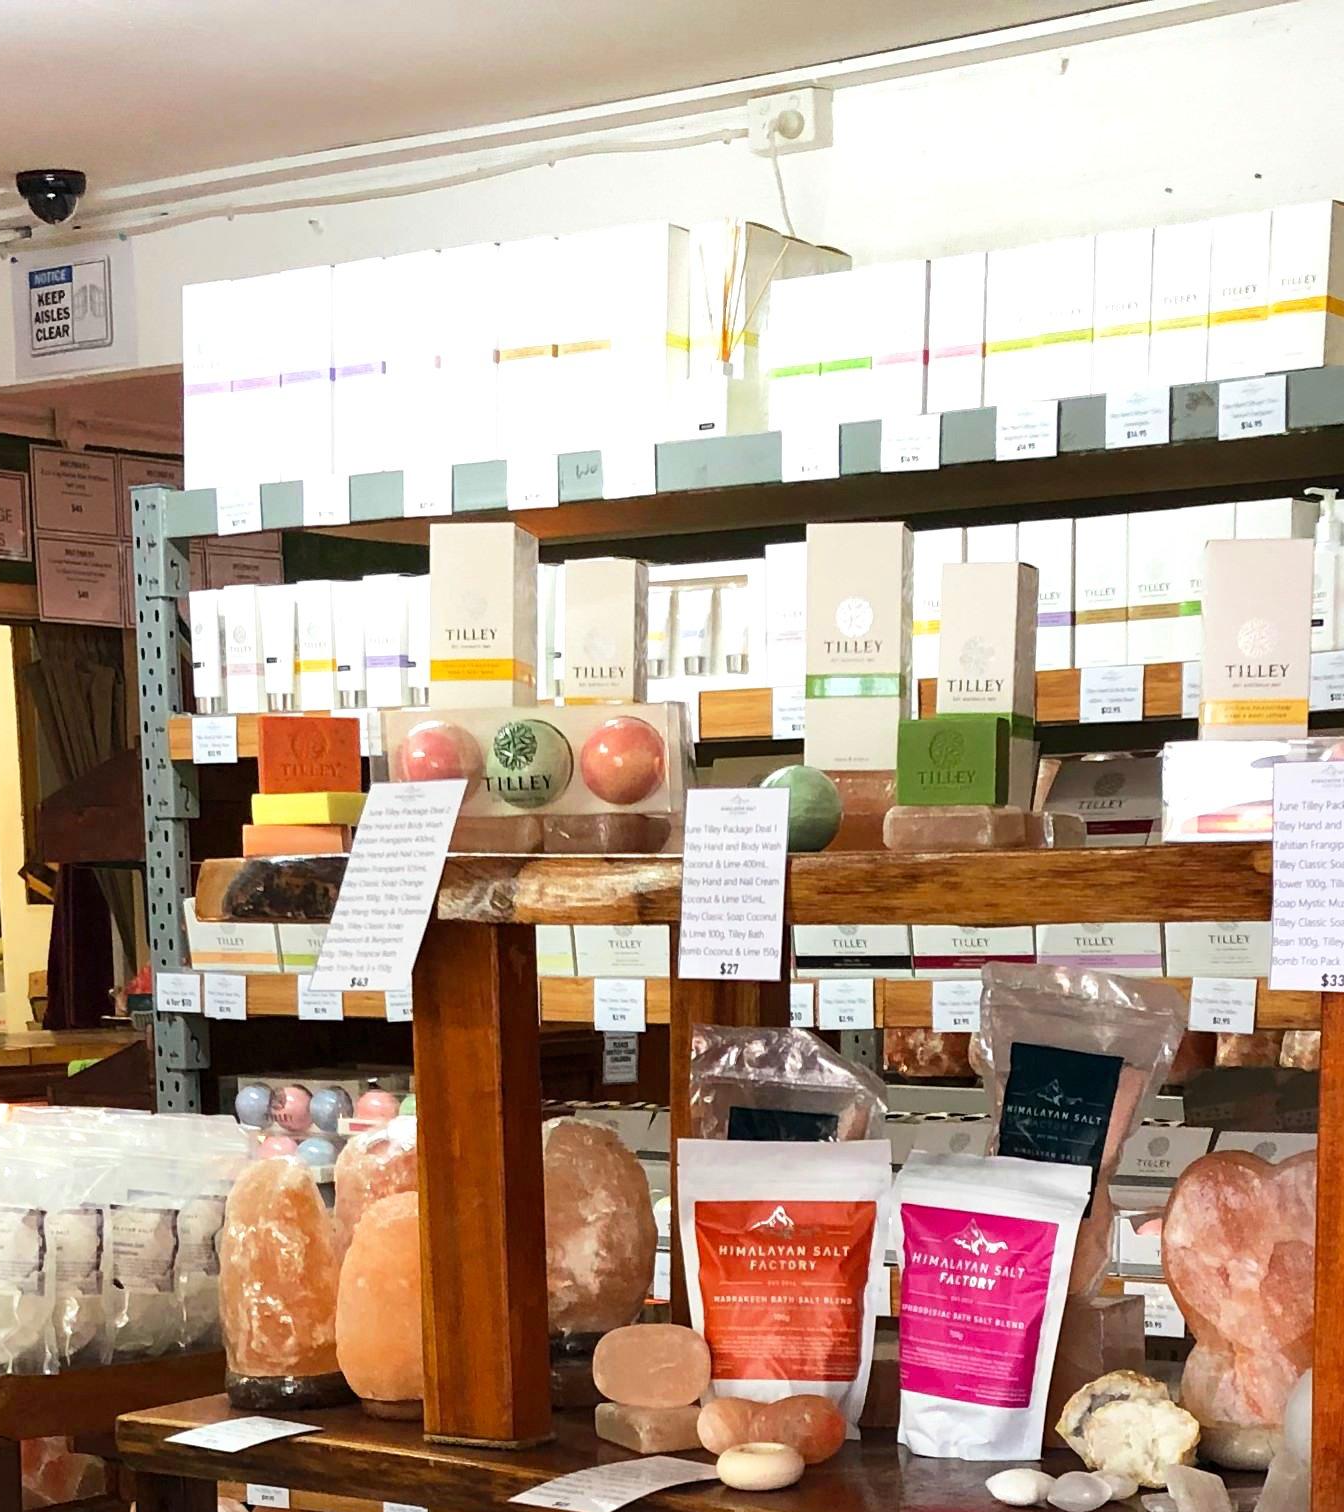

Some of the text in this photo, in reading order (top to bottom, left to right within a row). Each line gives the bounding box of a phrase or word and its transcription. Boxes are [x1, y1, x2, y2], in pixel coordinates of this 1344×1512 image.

[34, 269, 67, 285] NOTICE
[37, 290, 65, 307] KEEP
[34, 307, 70, 324] AISLES
[36, 325, 70, 342] CLEAR
[1084, 587, 1116, 597] TILLEY
[1137, 582, 1171, 593] TILLEY
[445, 627, 498, 641] TILLEY
[823, 640, 883, 654] TILLEY
[573, 666, 626, 680] TILLEY
[1225, 664, 1290, 678] TILLEY
[947, 679, 1004, 693] TILLEY
[917, 769, 976, 785] TILLEY
[484, 775, 552, 792] TILLEY
[1076, 798, 1126, 811] TILLEY
[1279, 801, 1298, 811] June
[1302, 800, 1323, 812] Tilley
[705, 823, 720, 835] Tilley
[724, 824, 754, 834] Package
[755, 824, 772, 833] Deal
[1274, 821, 1295, 832] Tilley
[1299, 820, 1322, 830] Hand
[1325, 820, 1342, 830] and
[704, 841, 723, 850] Hand
[726, 842, 739, 850] and
[741, 842, 759, 852] Body
[762, 841, 782, 850] Wash
[1274, 840, 1308, 850] Tahitian
[684, 860, 740, 868] Coconut & Lime
[1274, 859, 1295, 871] Tilley
[1298, 859, 1327, 869] Classic
[703, 877, 722, 886] Hand
[724, 877, 737, 885] and
[739, 877, 754, 885] Nail
[755, 877, 779, 885] Cream
[1274, 879, 1303, 889] Flower
[683, 894, 739, 904] Coconut & Lime
[1273, 899, 1296, 910] Soap
[1298, 898, 1324, 910] Mystic
[701, 913, 723, 921] Classic
[726, 913, 744, 922] Soap
[746, 913, 777, 921] Coconut
[1274, 918, 1295, 929] Tilley
[1298, 918, 1326, 927] Classic
[689, 930, 764, 940] Lime Tilley Bath
[1208, 934, 1250, 945] TILLEY
[217, 937, 244, 946] TILLEY
[608, 939, 643, 948] TILLEY
[832, 939, 868, 948] TILLEY
[952, 938, 989, 948] TILLEY
[1074, 937, 1115, 946] TILLEY
[1273, 937, 1295, 946] Bean
[1323, 937, 1344, 948] Tilley
[703, 947, 733, 956] Coconut
[735, 948, 741, 956] &
[743, 947, 761, 956] Lime
[763, 947, 779, 958] 150g
[1273, 957, 1298, 966] Bomb
[1301, 956, 1318, 966] Trio
[1320, 956, 1340, 966] Pack
[720, 963, 739, 975] $27
[1321, 974, 1344, 987] $33
[1007, 1104, 1102, 1126] HIMALAYAN SALT
[719, 1245, 850, 1257] HIMALAYAN SALT
[750, 1260, 816, 1271] FACTORY
[912, 1252, 1025, 1279] HIMALAYAN SALT
[940, 1272, 996, 1291] FACTORY
[799, 1296, 820, 1304] SALT
[824, 1297, 852, 1305] BLEND
[953, 1312, 1024, 1330] BATH SALT BLEND
